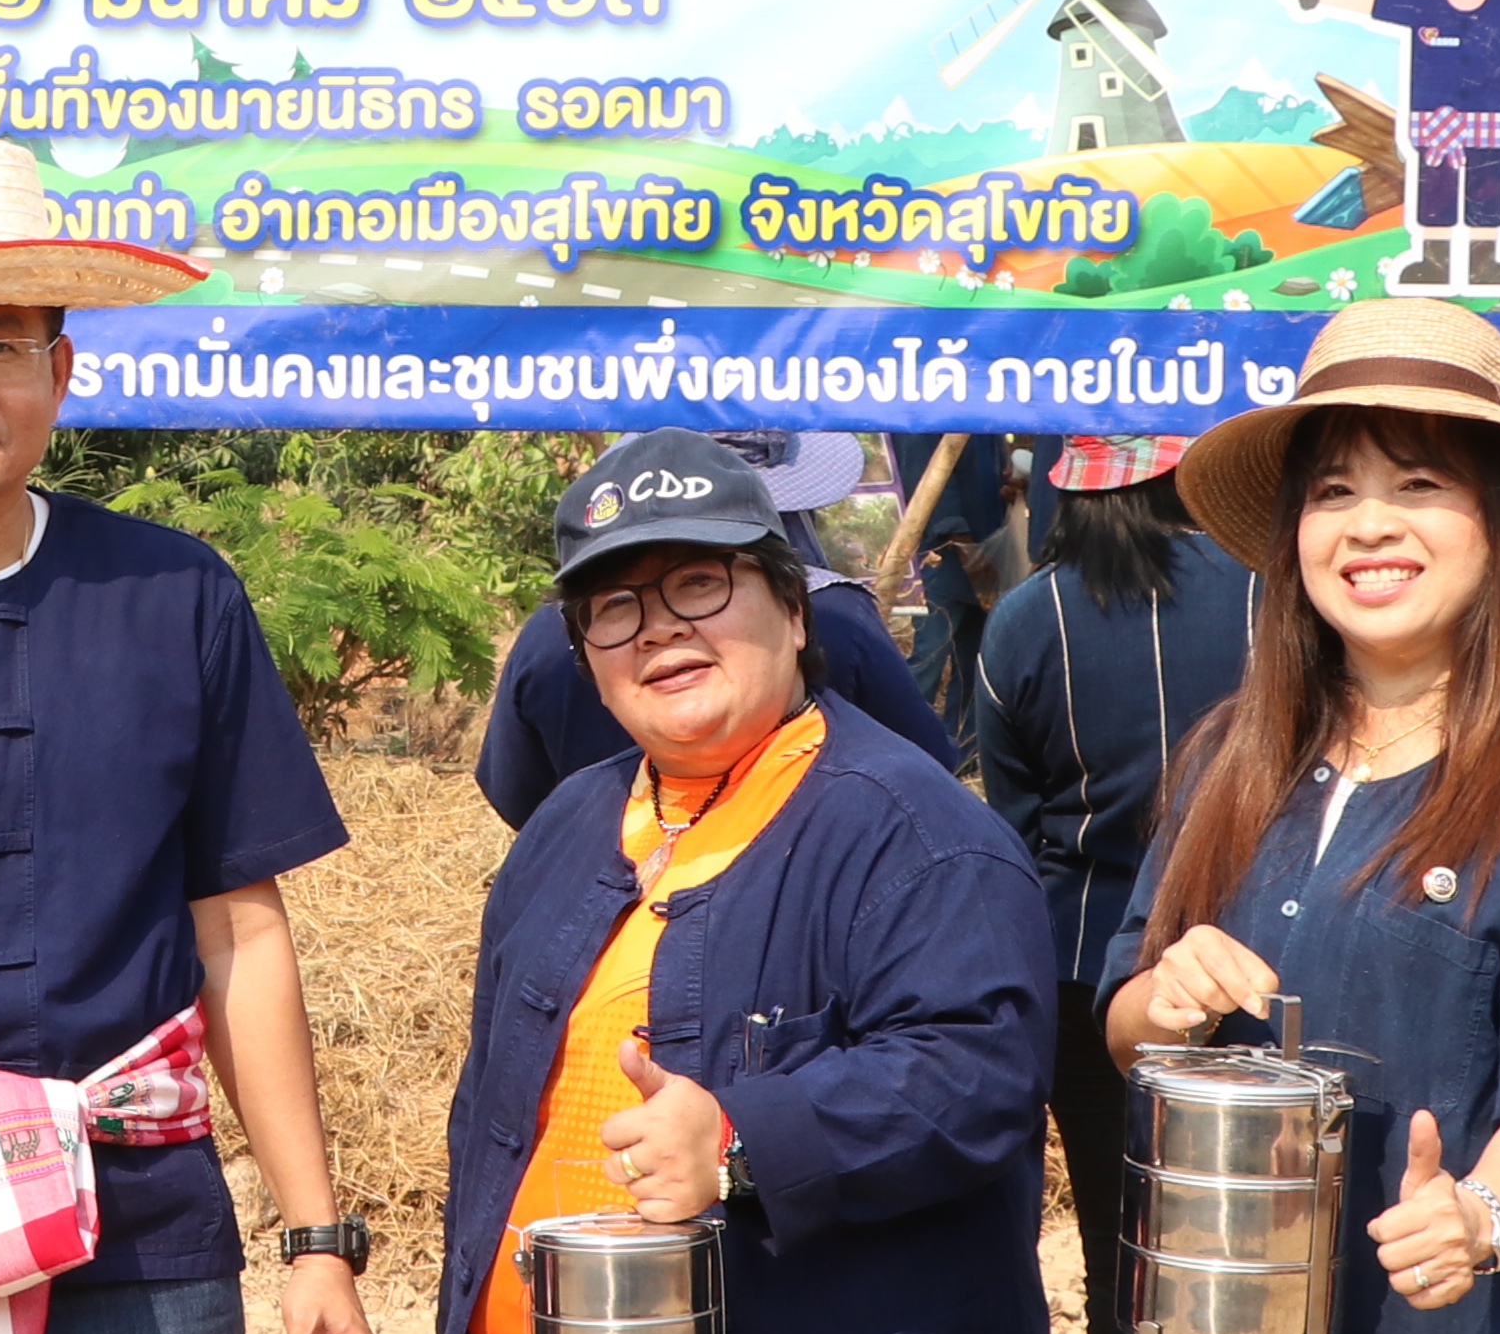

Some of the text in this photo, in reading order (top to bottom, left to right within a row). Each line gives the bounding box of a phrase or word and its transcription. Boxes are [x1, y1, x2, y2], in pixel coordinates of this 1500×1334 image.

[521, 80, 725, 130] รอดมา
[219, 174, 716, 264] อำเภอเมืองสุโขทัย
[745, 175, 1132, 262] จังหวัดสุโขทัย
[986, 338, 1227, 405] ภายในปี
[627, 469, 714, 502] CDD
